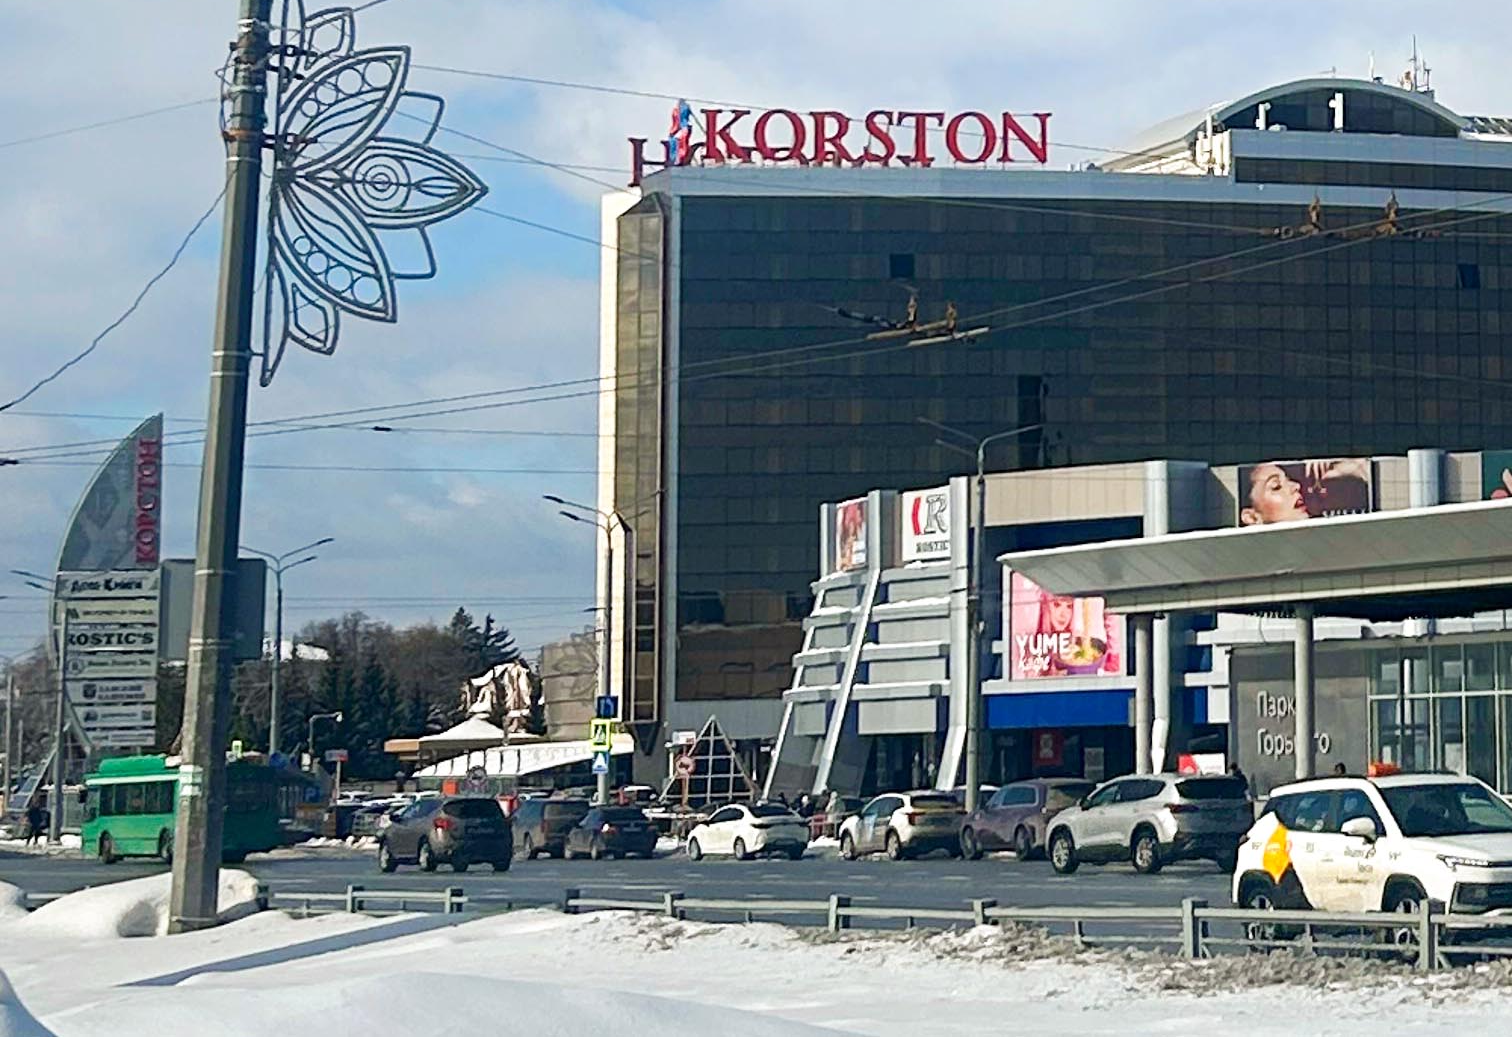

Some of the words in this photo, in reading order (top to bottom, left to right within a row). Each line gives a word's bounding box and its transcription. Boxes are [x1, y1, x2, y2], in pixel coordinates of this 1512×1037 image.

[701, 108, 1052, 164] KORSTON
[136, 437, 158, 563] КОРСТОН
[1015, 633, 1072, 656] YUME
[1257, 690, 1296, 722] Парк
[1257, 728, 1330, 761] Горьо
